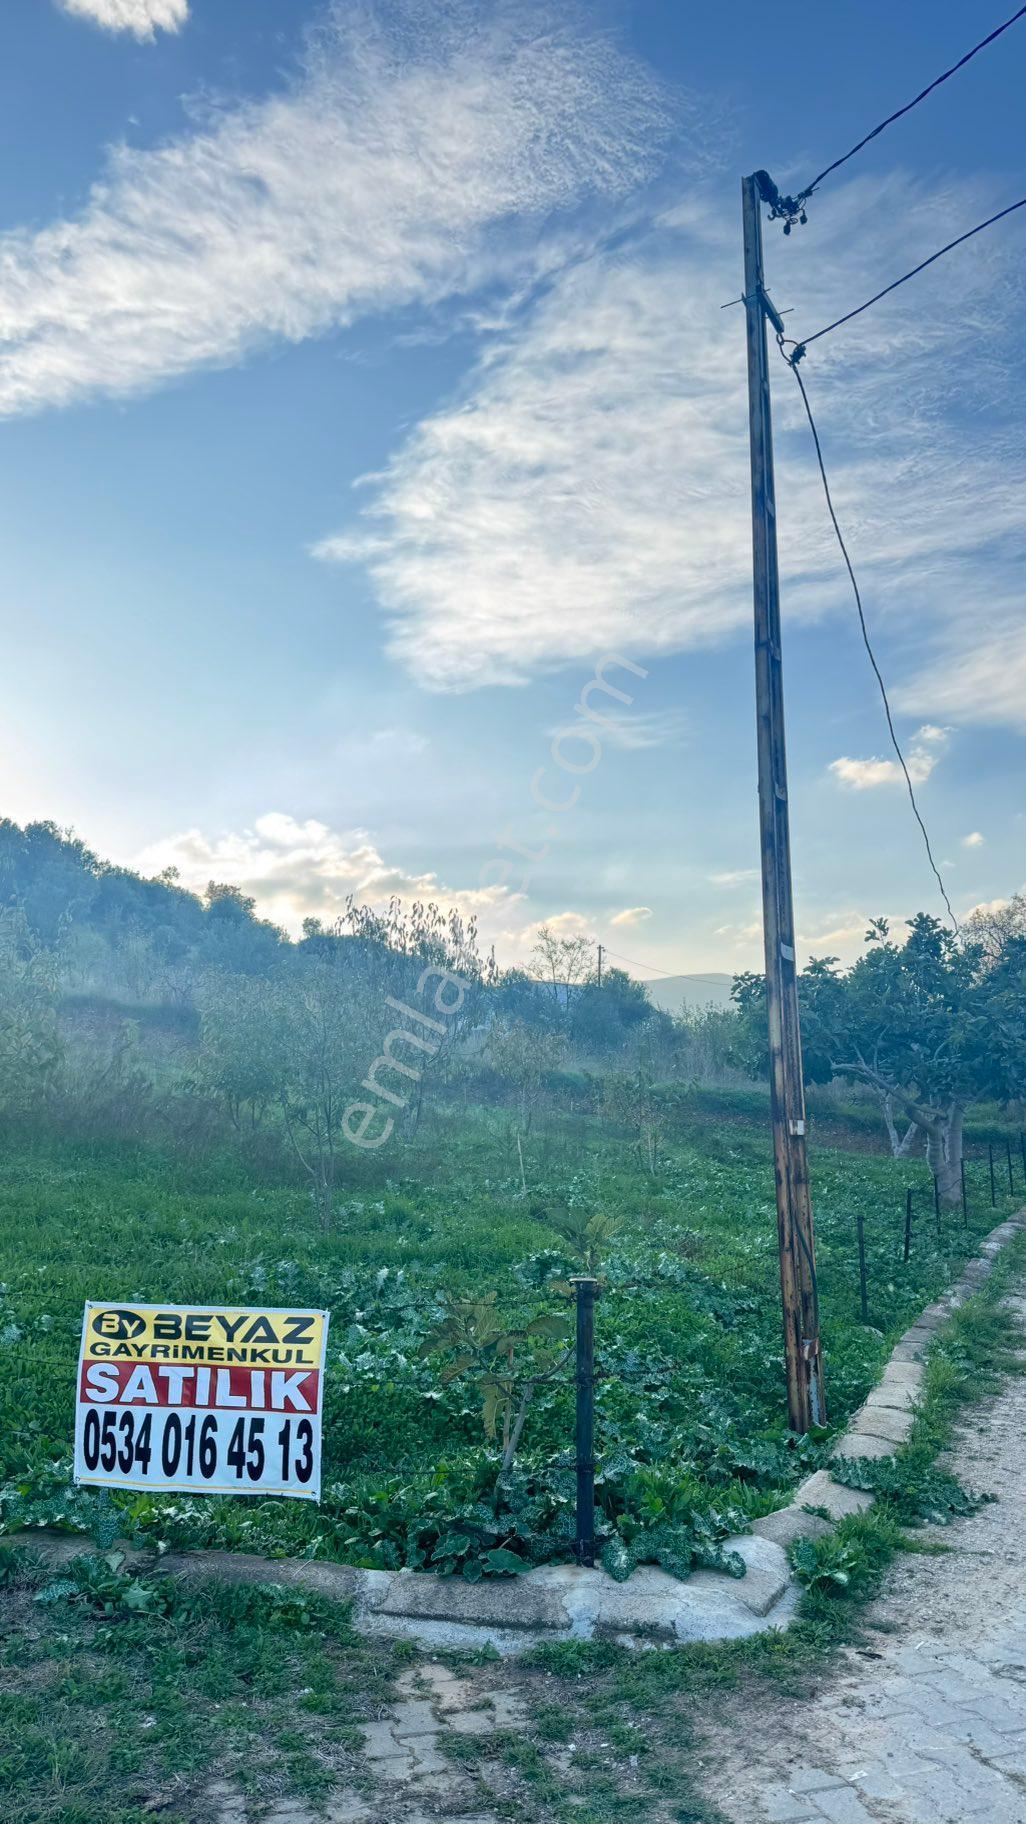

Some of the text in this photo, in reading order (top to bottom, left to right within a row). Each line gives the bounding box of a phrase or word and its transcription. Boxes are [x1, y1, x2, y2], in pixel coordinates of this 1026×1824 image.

[153, 1313, 315, 1345] BEYAZ
[85, 1362, 312, 1411] SATILIK
[83, 1408, 313, 1484] 0534 016 45 13
